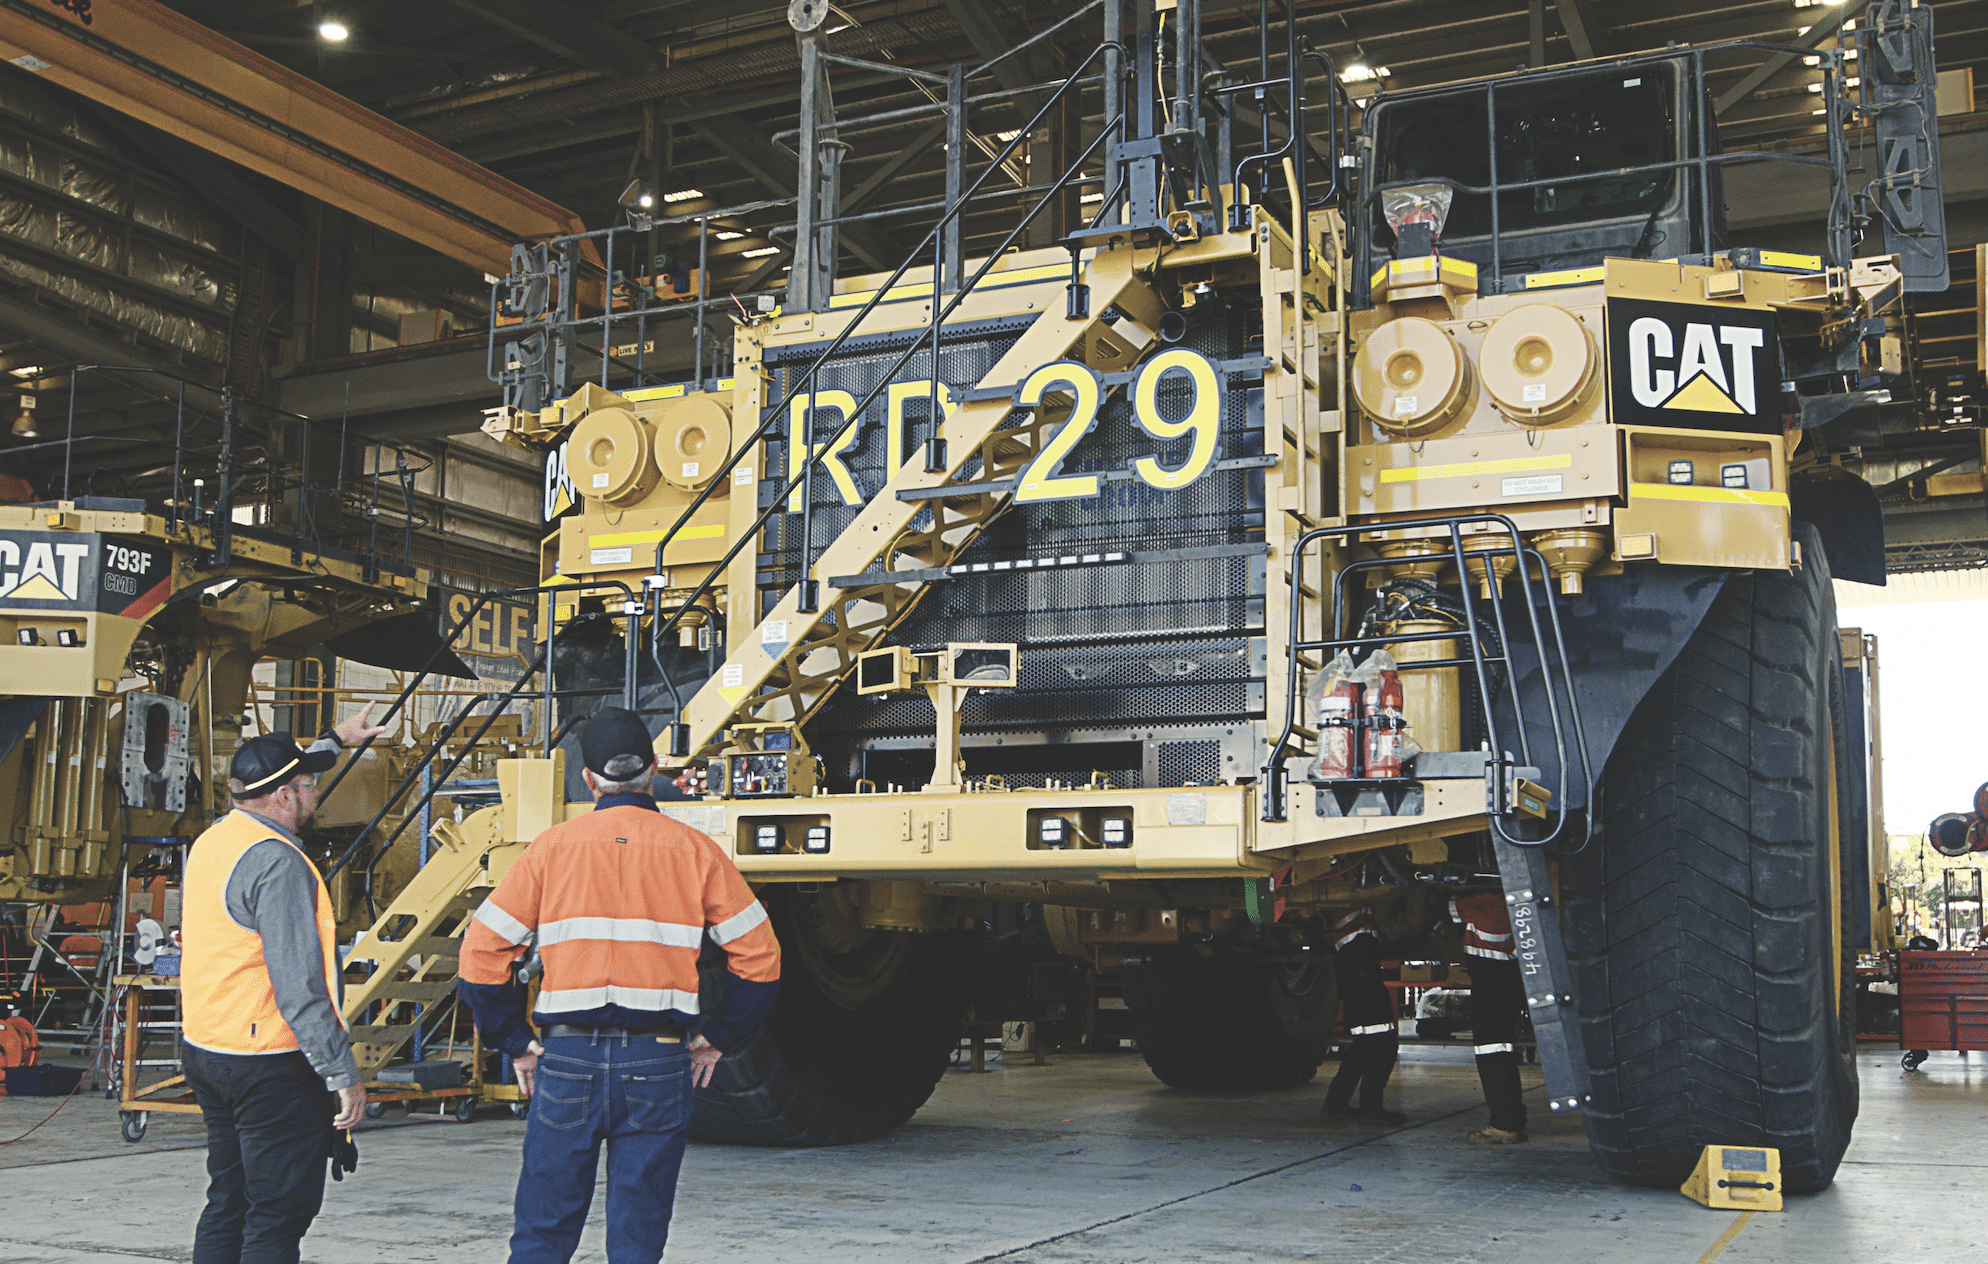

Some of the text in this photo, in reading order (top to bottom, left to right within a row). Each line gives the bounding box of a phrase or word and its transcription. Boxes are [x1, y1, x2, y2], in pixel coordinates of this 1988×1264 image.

[1629, 317, 1764, 416] CAT
[1015, 350, 1220, 502] 29
[0, 539, 89, 601] CAT
[104, 572, 137, 595] CMD
[106, 544, 152, 575] 793F
[447, 593, 529, 656] SELF
